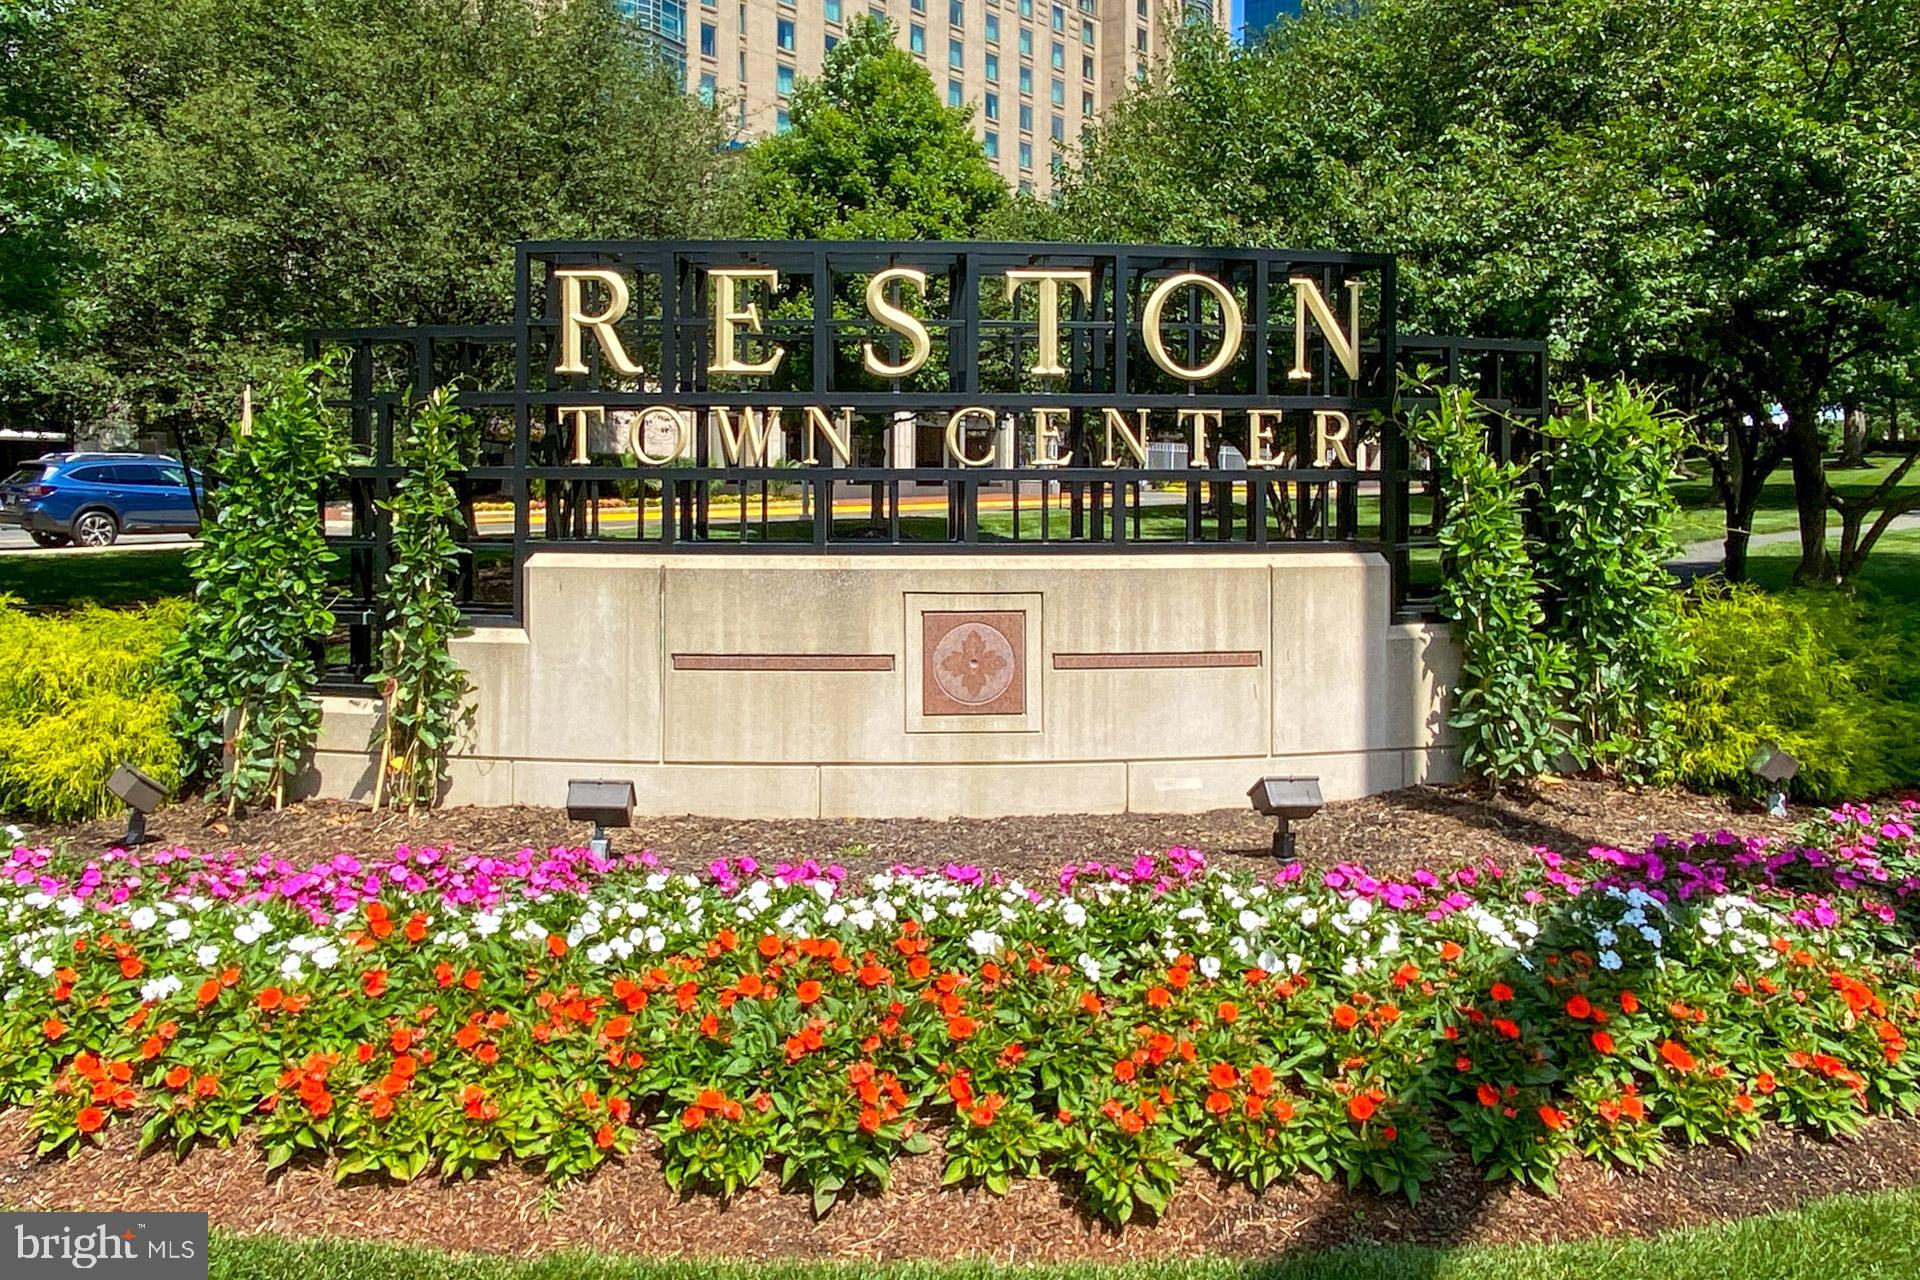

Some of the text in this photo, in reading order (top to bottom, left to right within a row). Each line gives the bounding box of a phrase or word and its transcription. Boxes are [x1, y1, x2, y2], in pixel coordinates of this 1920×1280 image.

[554, 268, 1363, 381] RESTON
[557, 405, 1357, 468] TOWN CENTER
